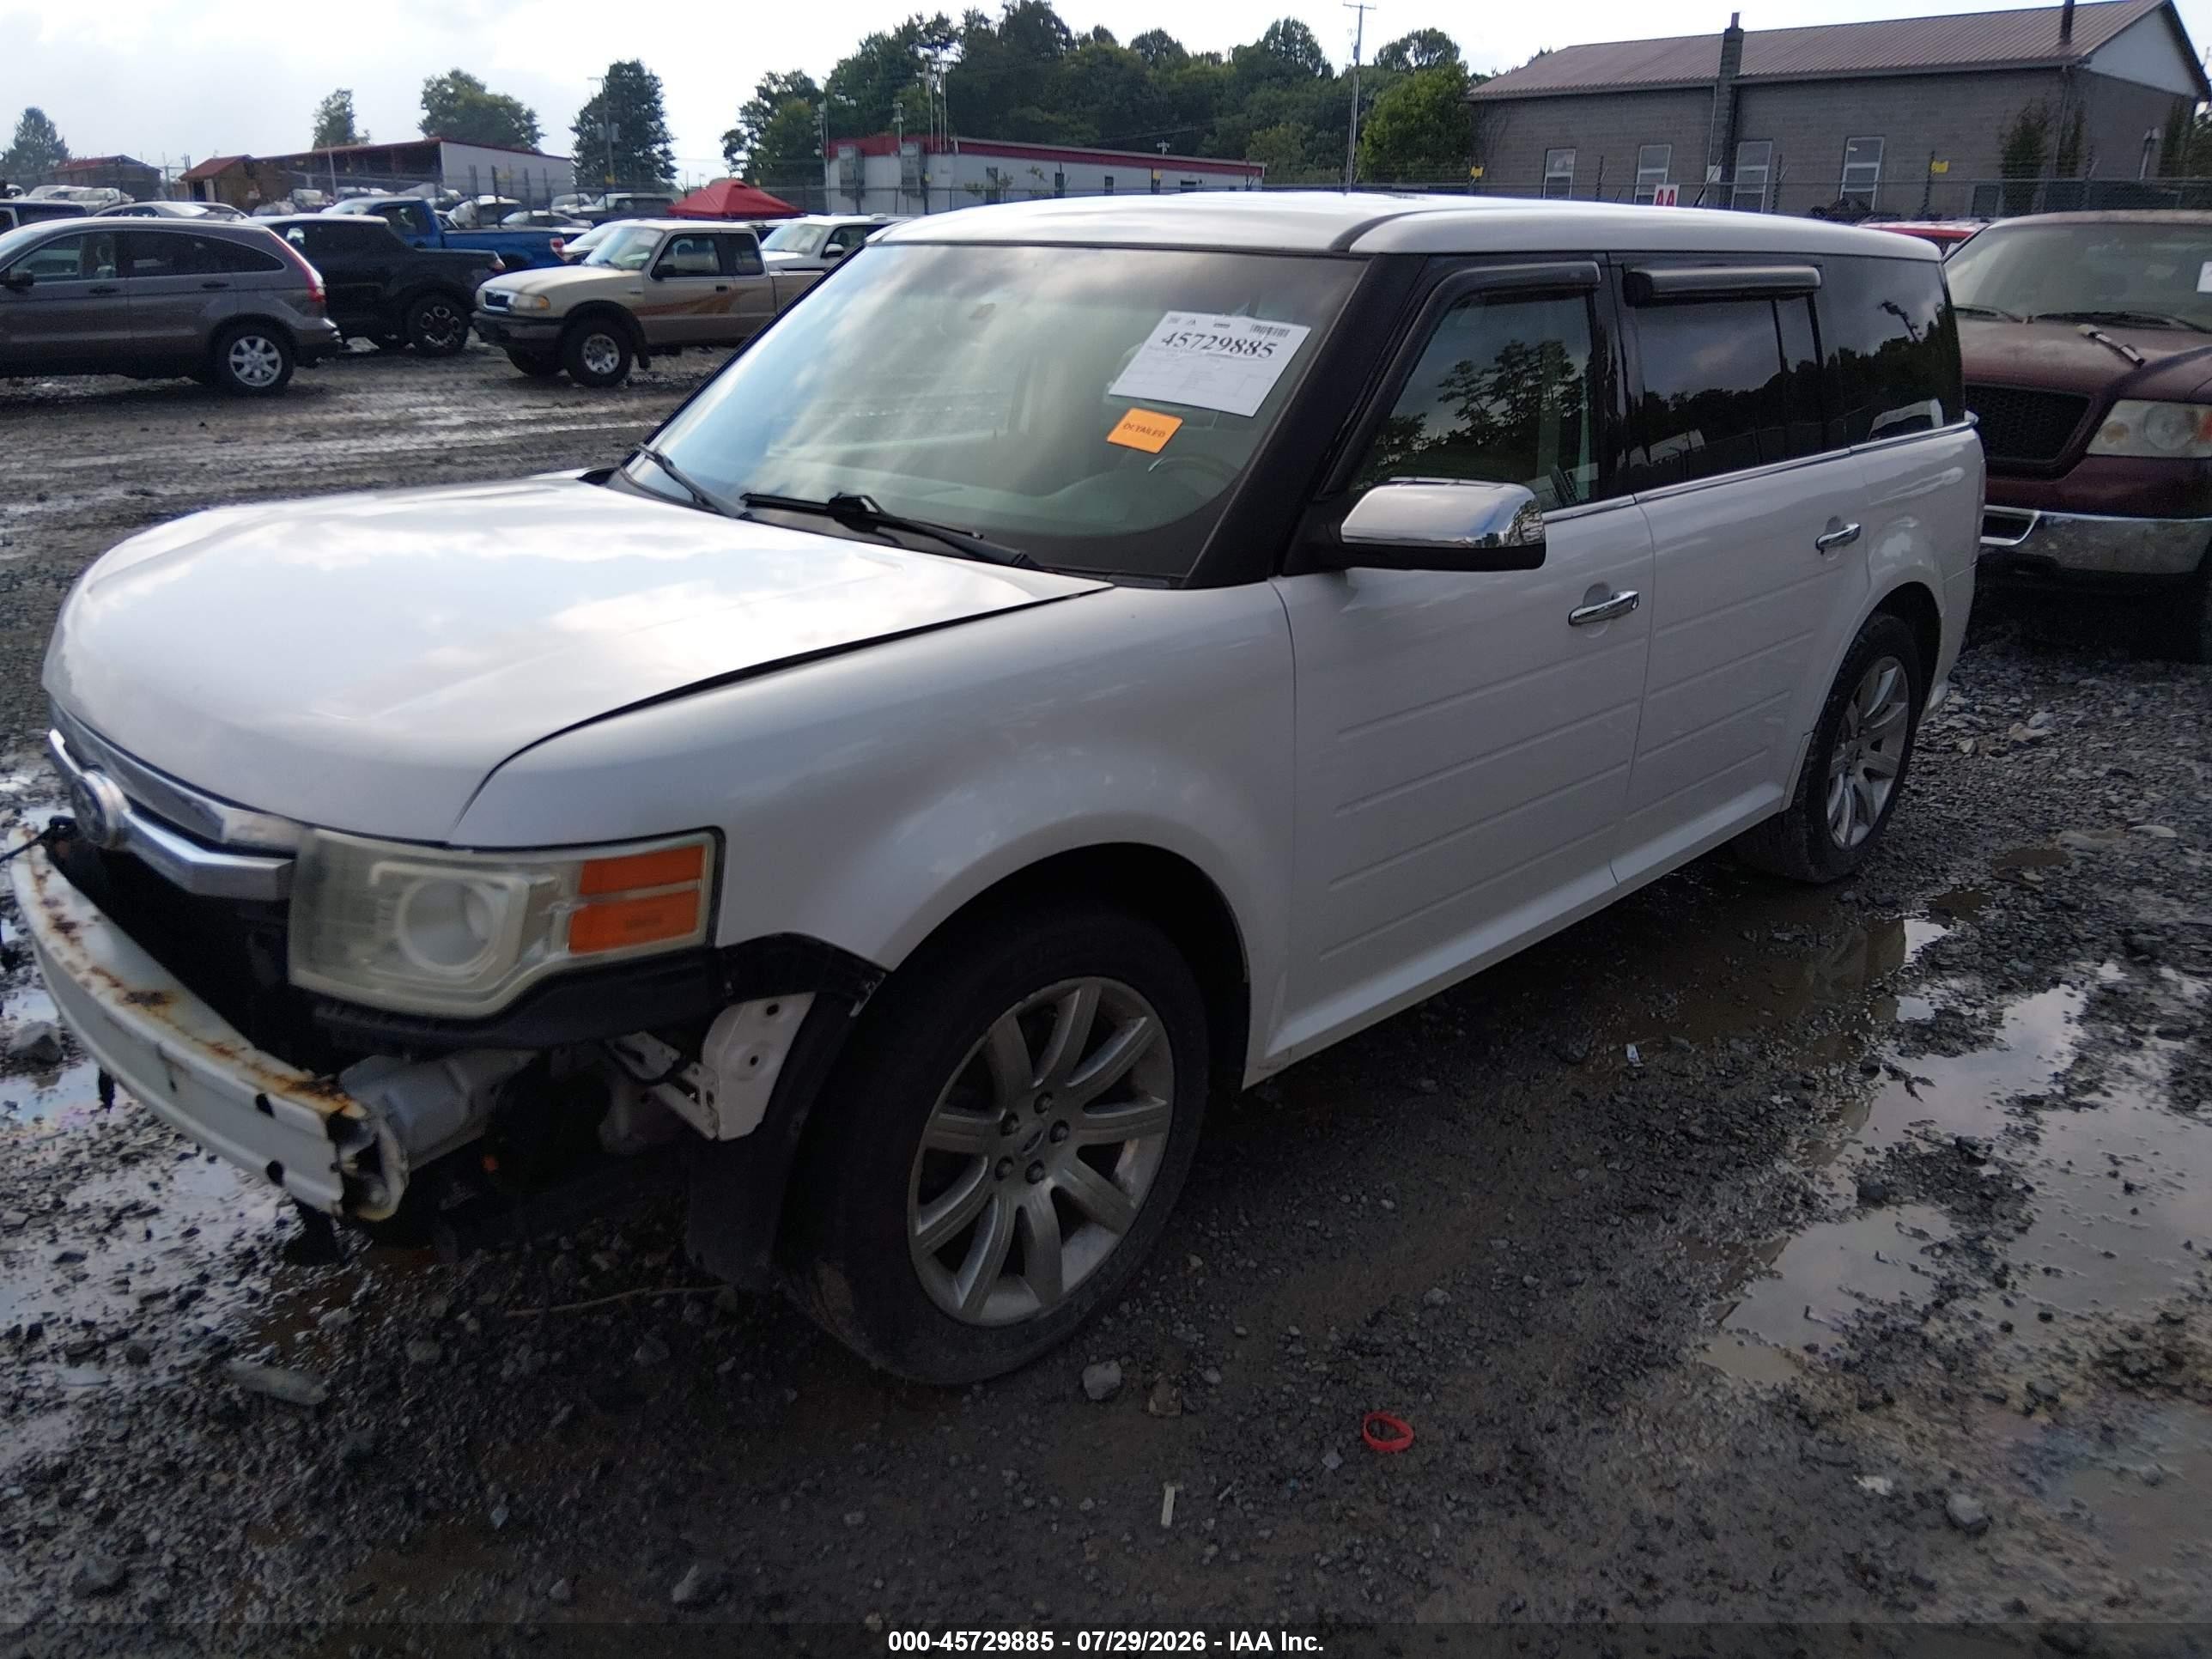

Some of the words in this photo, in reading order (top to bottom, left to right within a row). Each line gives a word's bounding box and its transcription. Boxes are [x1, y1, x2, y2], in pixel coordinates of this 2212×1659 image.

[1656, 189, 1675, 206] AA
[1160, 331, 1278, 359] 45729885
[1122, 422, 1166, 439] DETAILED
